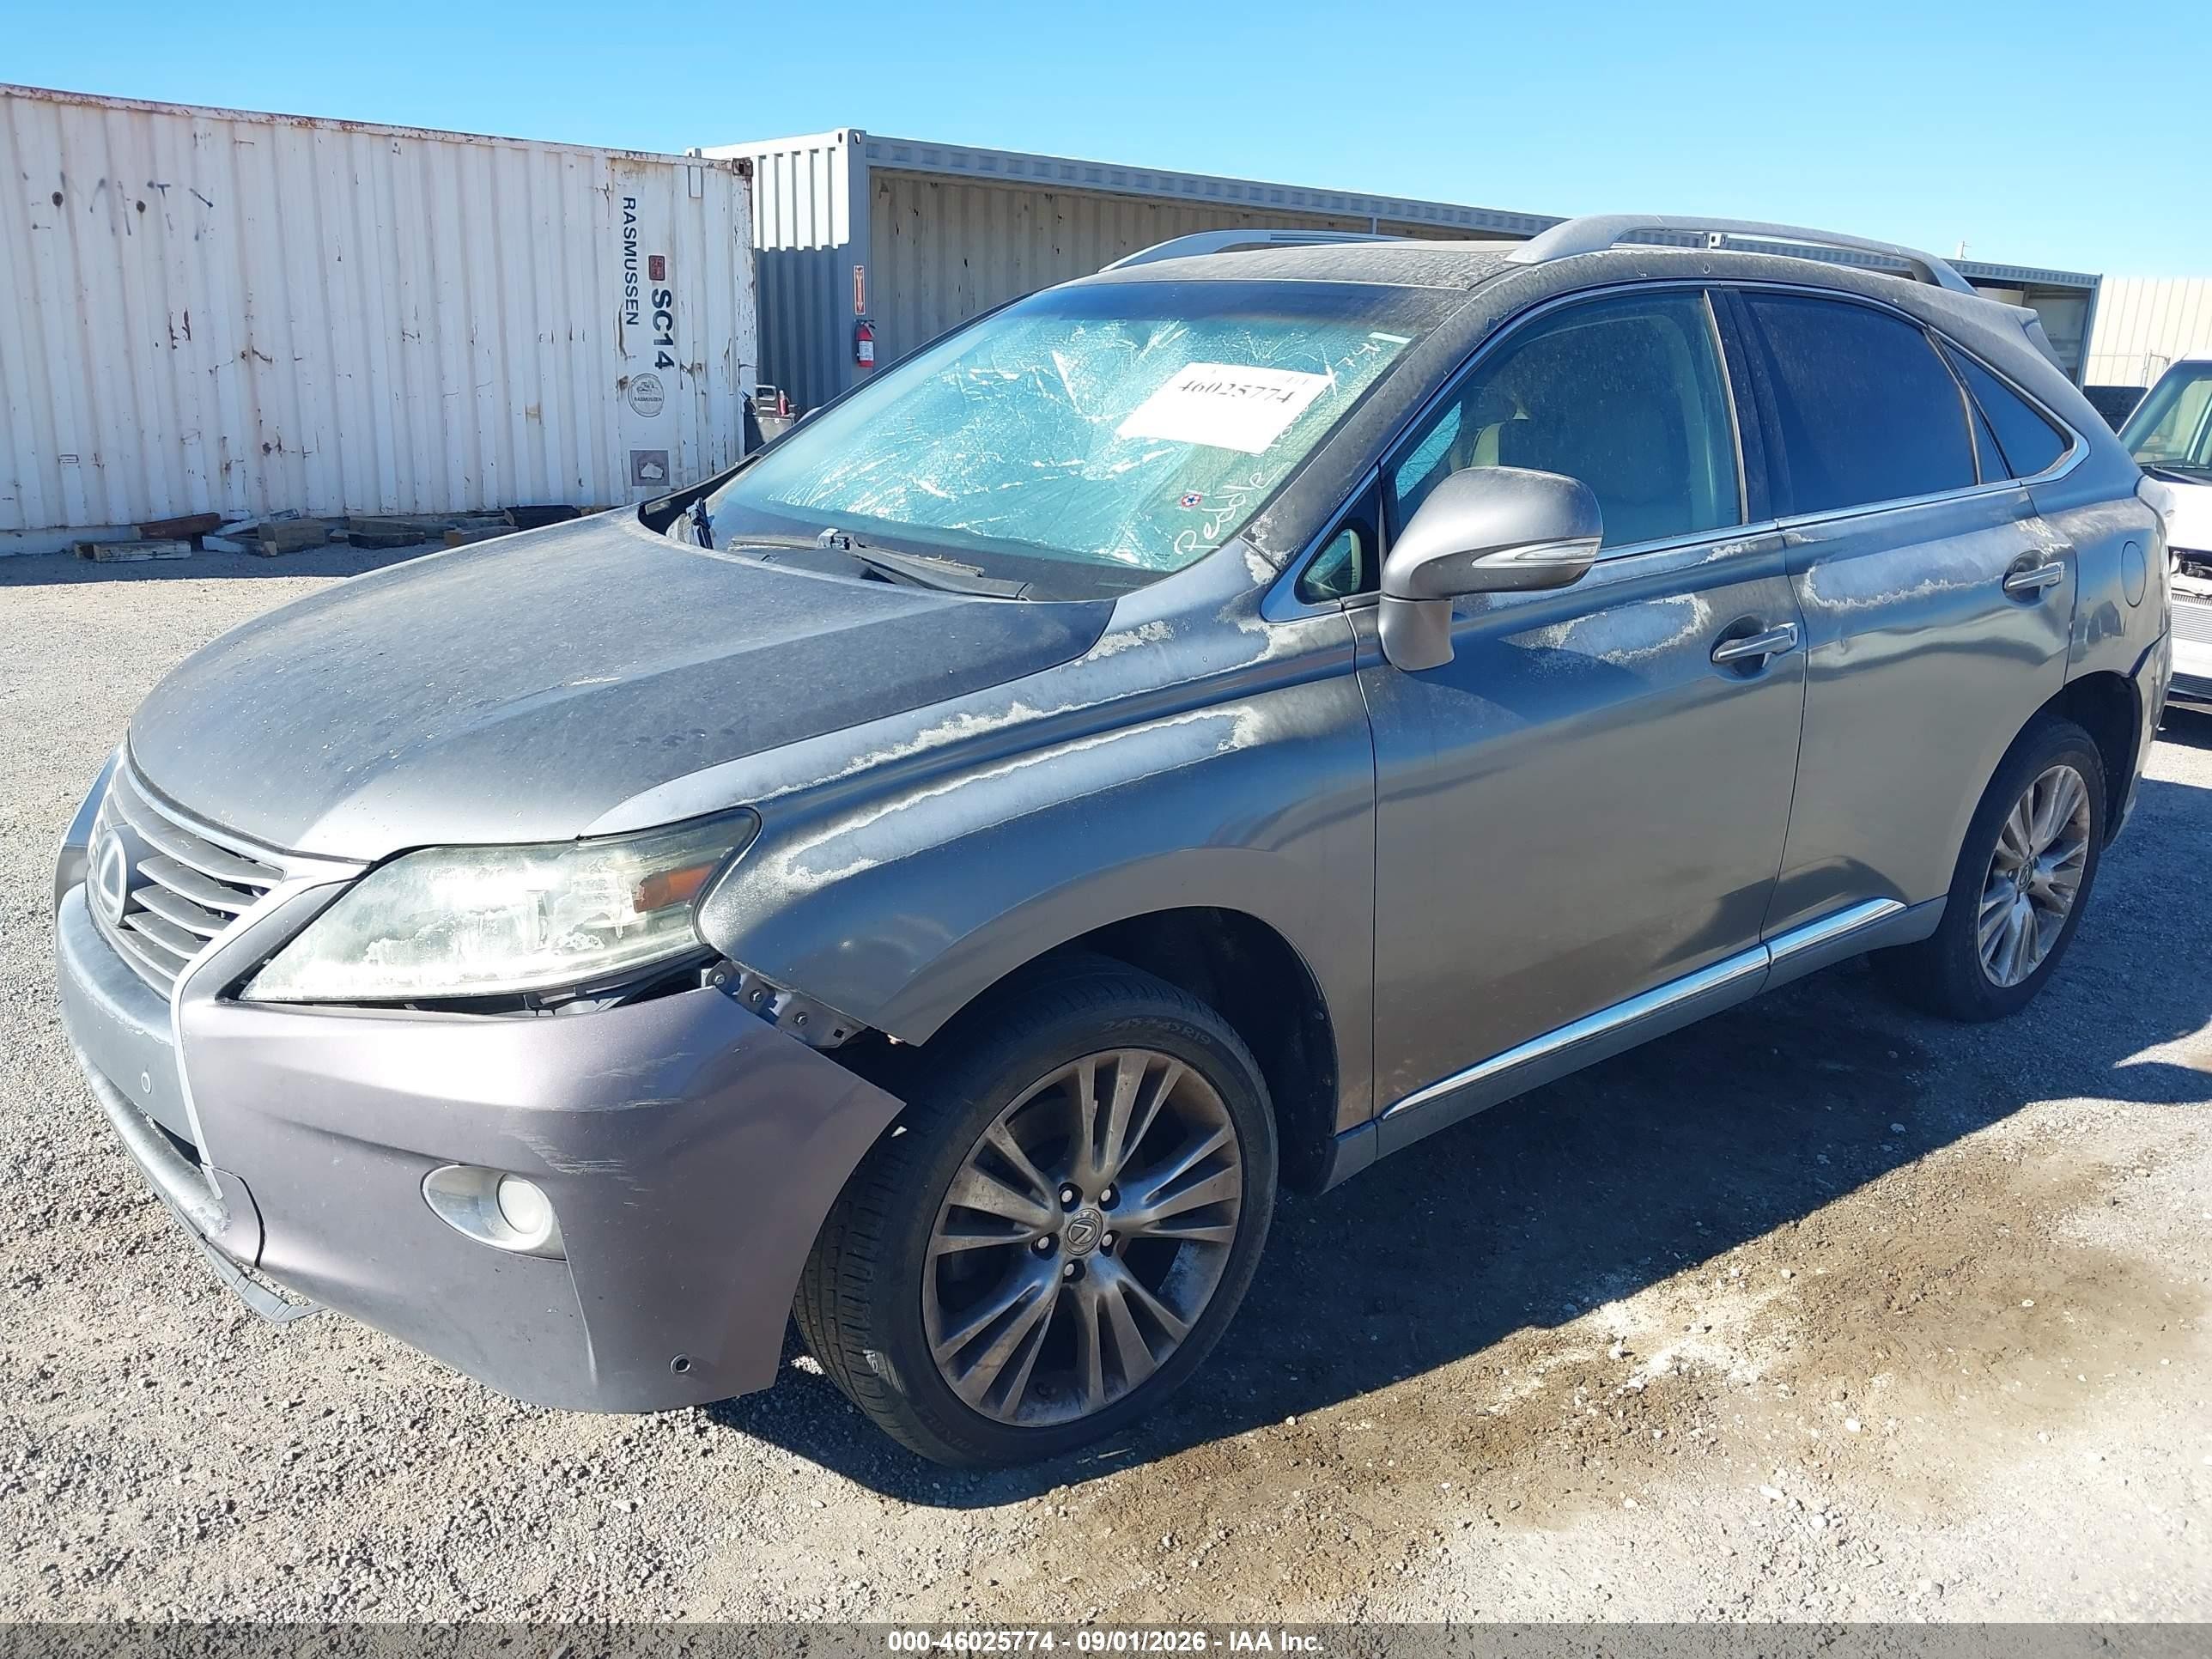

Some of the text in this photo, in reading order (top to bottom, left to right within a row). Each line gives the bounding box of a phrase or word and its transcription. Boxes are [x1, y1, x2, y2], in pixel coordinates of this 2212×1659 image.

[623, 197, 639, 325] RASMUSSEN
[652, 288, 675, 370] SC14
[1179, 380, 1295, 404] 46025774
